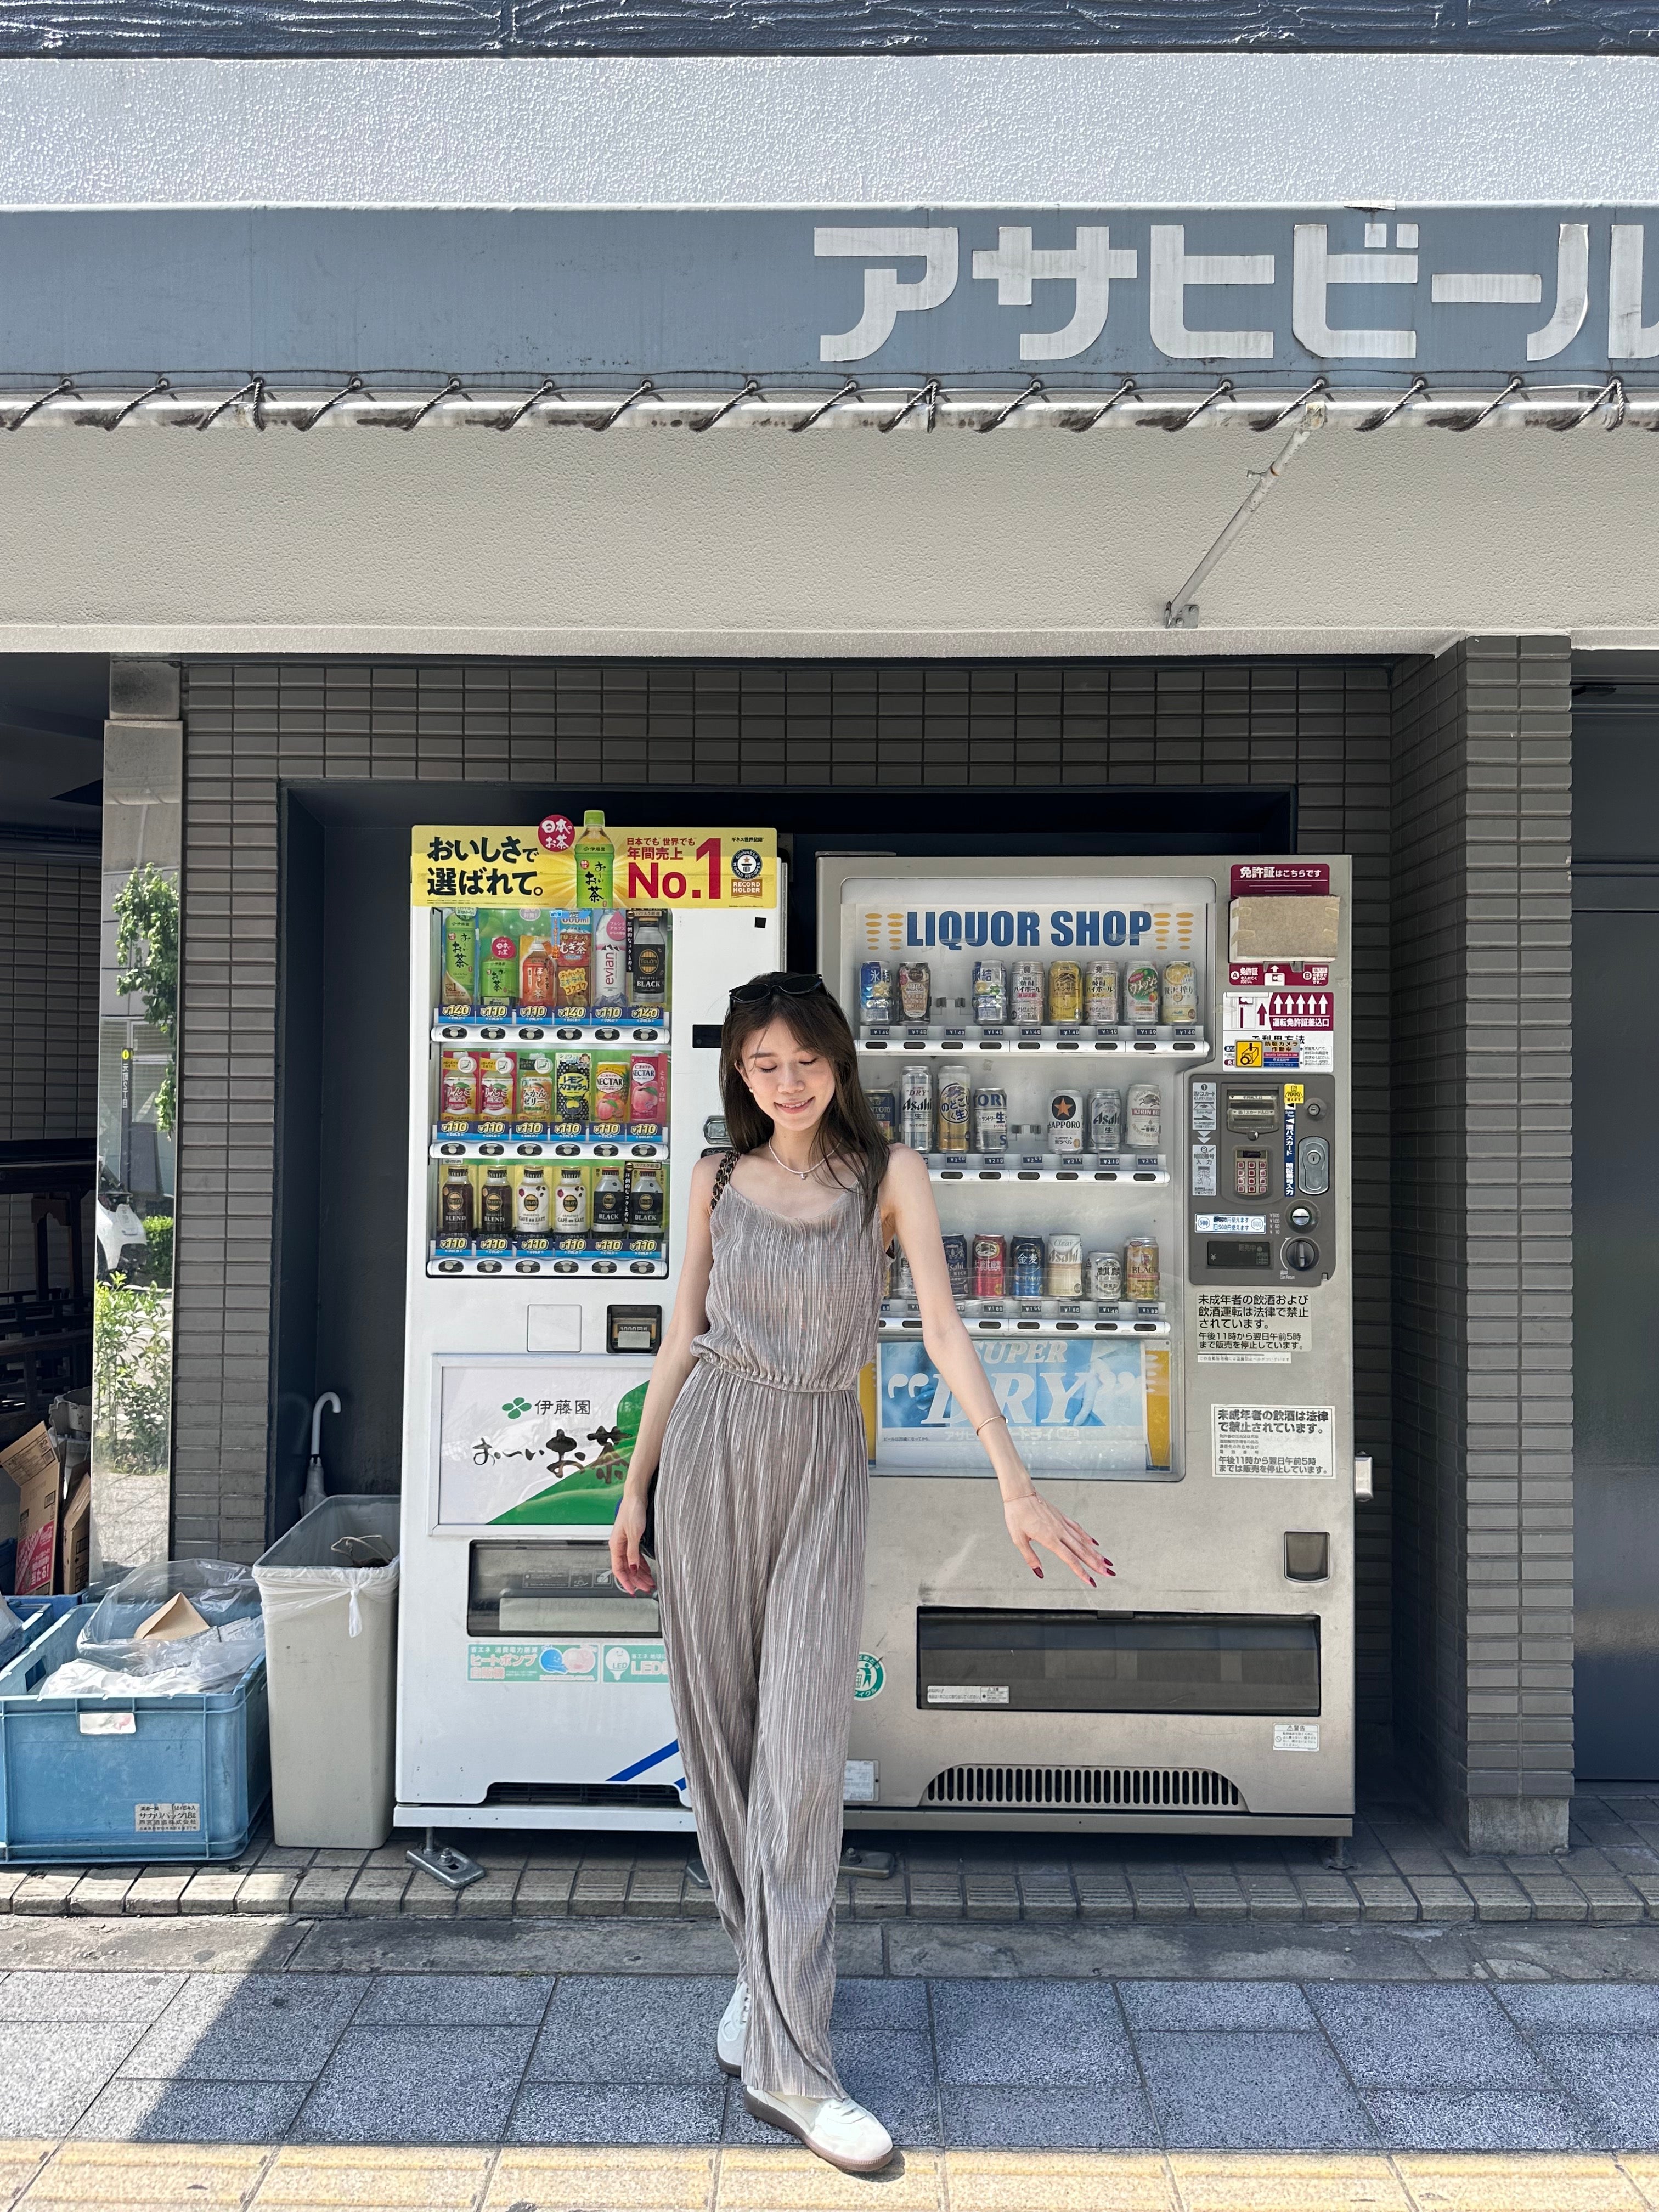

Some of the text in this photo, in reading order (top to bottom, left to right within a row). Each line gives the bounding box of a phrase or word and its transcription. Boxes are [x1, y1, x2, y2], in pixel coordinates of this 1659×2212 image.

[814, 223, 1659, 361] アサヒビール
[541, 819, 572, 834] 日本の
[545, 835, 568, 850] お茶
[427, 836, 539, 864] おいしさで
[627, 847, 684, 860] 年間売上
[628, 838, 721, 899] No.1
[1240, 866, 1322, 878] 免許証はこちらです
[427, 867, 543, 896] 選ばれて。
[585, 871, 603, 903] お茶
[907, 910, 1152, 950] LIQUOR SHOP
[560, 941, 588, 955] むぎ茶
[452, 941, 468, 968] お茶
[603, 952, 614, 985] evian
[1240, 967, 1258, 976] 免許証
[870, 969, 891, 983] 氷結
[973, 969, 992, 982] 氷結
[443, 1005, 470, 1016] ¥140
[481, 1006, 507, 1017] ¥110
[520, 1006, 547, 1017] ¥110
[558, 1007, 586, 1018] ¥140
[596, 1007, 622, 1018] ¥110
[632, 1007, 659, 1018] ¥140
[1272, 1018, 1329, 1027] 運転免許証差込口
[523, 1089, 546, 1097] みかん
[902, 1098, 932, 1111] Asahi
[442, 1122, 469, 1132] ¥110
[478, 1122, 505, 1134] ¥110
[516, 1123, 543, 1134] ¥110
[555, 1123, 582, 1135] ¥110
[594, 1124, 620, 1135] ¥110
[631, 1124, 658, 1135] ¥110
[1049, 1121, 1080, 1129] SAPPORO
[1285, 1124, 1294, 1156] 酒パスカード
[441, 1238, 467, 1249] ¥110
[481, 1238, 508, 1250] ¥110
[522, 1239, 549, 1250] ¥110
[560, 1239, 586, 1251] ¥110
[596, 1239, 623, 1251] ¥110
[630, 1240, 657, 1251] ¥110
[1017, 1254, 1039, 1265] 金麦
[1198, 1294, 1309, 1305] 未成年者の飲酒および
[1198, 1306, 1309, 1317] 飲酒運転は法律で禁止
[1199, 1318, 1268, 1329] されています。
[1199, 1332, 1301, 1341] 午後11時から翌日午前5時
[1199, 1341, 1303, 1350] まで販売を停止しています。
[534, 1399, 591, 1415] 伊藤園
[1217, 1409, 1329, 1422] 未成年者の飲酒は法律
[1218, 1421, 1323, 1434] で禁止されています。
[1218, 1455, 1317, 1465] 午後11時から翌日午前5時
[1219, 1465, 1328, 1475] までは販売を停止しています。
[470, 1653, 538, 1667] ヒートポンプ
